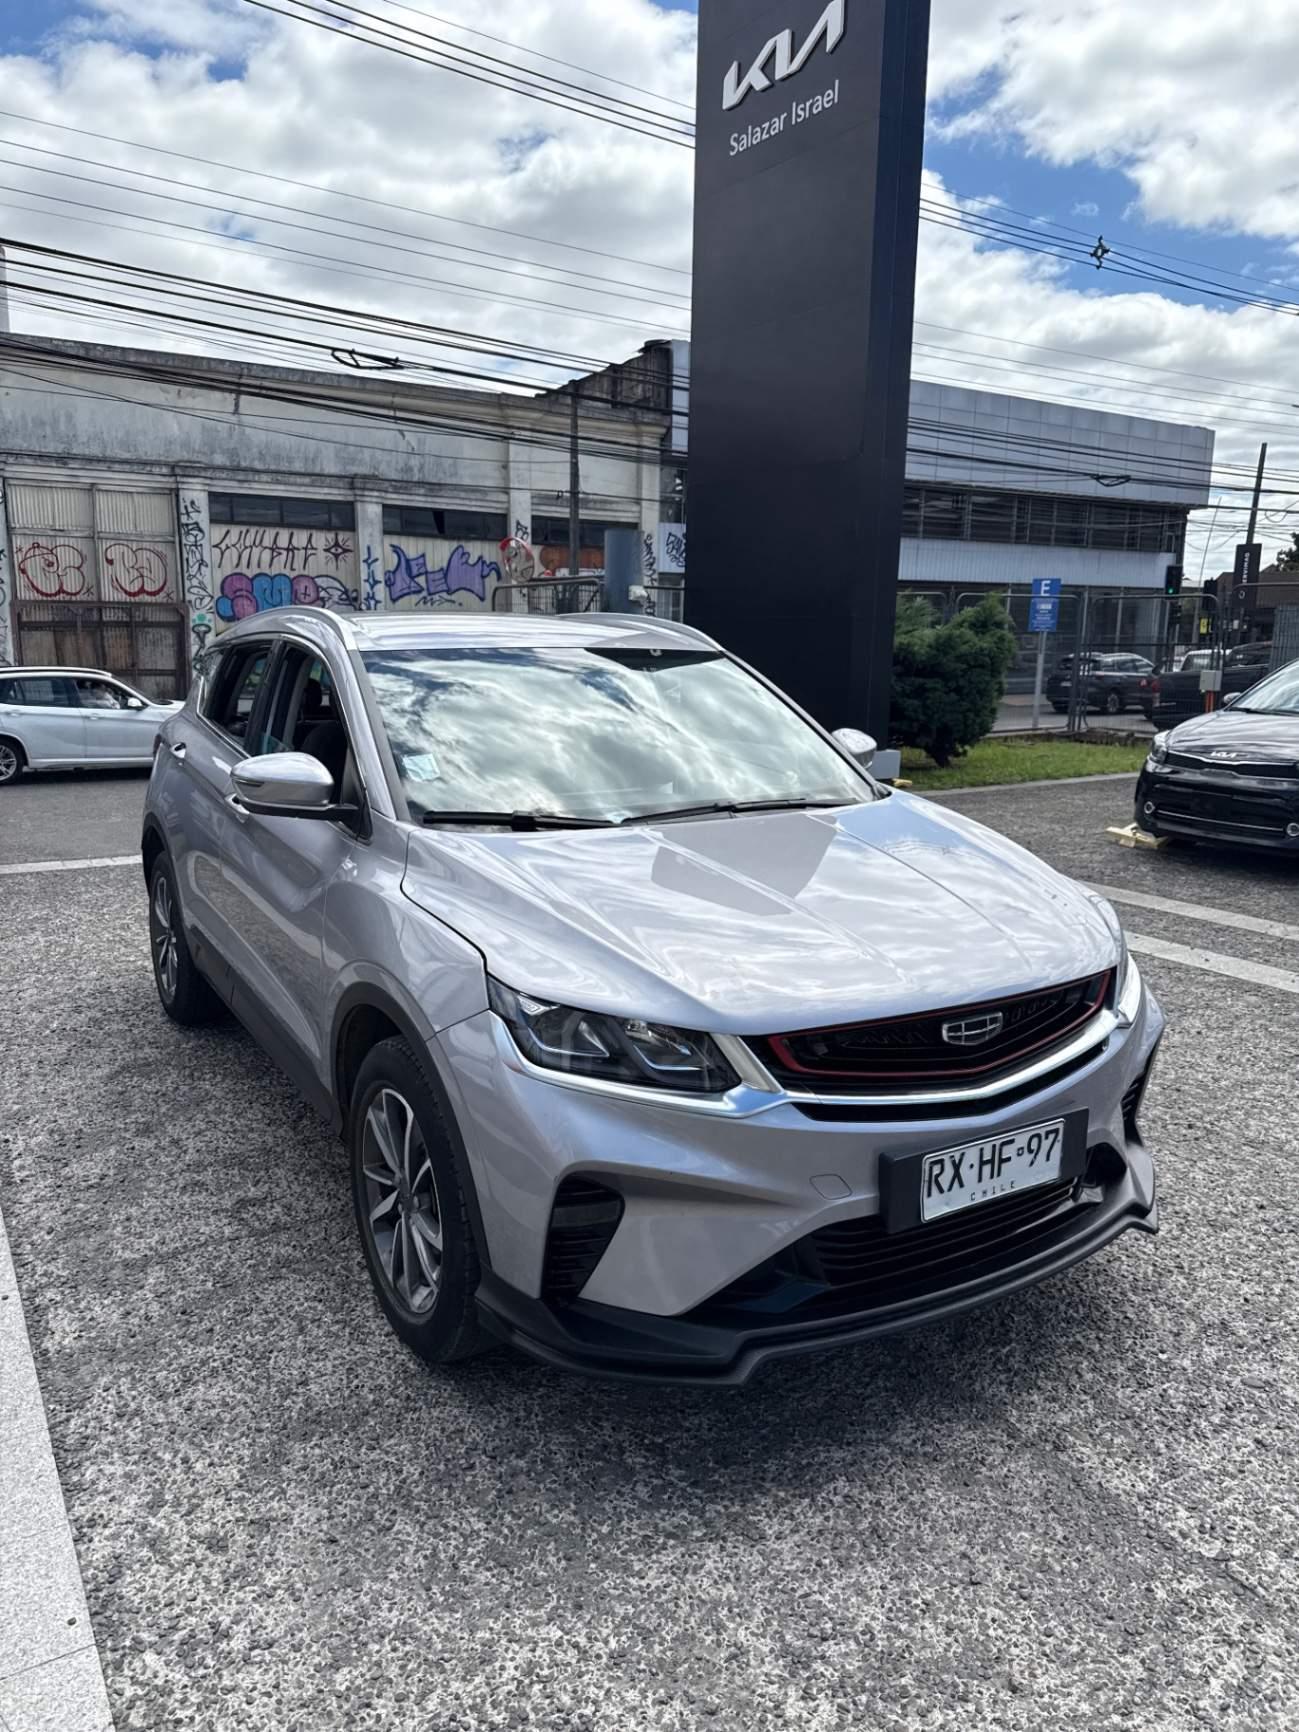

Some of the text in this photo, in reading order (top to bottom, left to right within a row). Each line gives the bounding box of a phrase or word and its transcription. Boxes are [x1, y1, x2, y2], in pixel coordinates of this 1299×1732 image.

[722, 0, 845, 110] KIA
[729, 79, 840, 156] Salazar Israel
[1040, 579, 1051, 597] E
[970, 1180, 1016, 1201] CHILE
